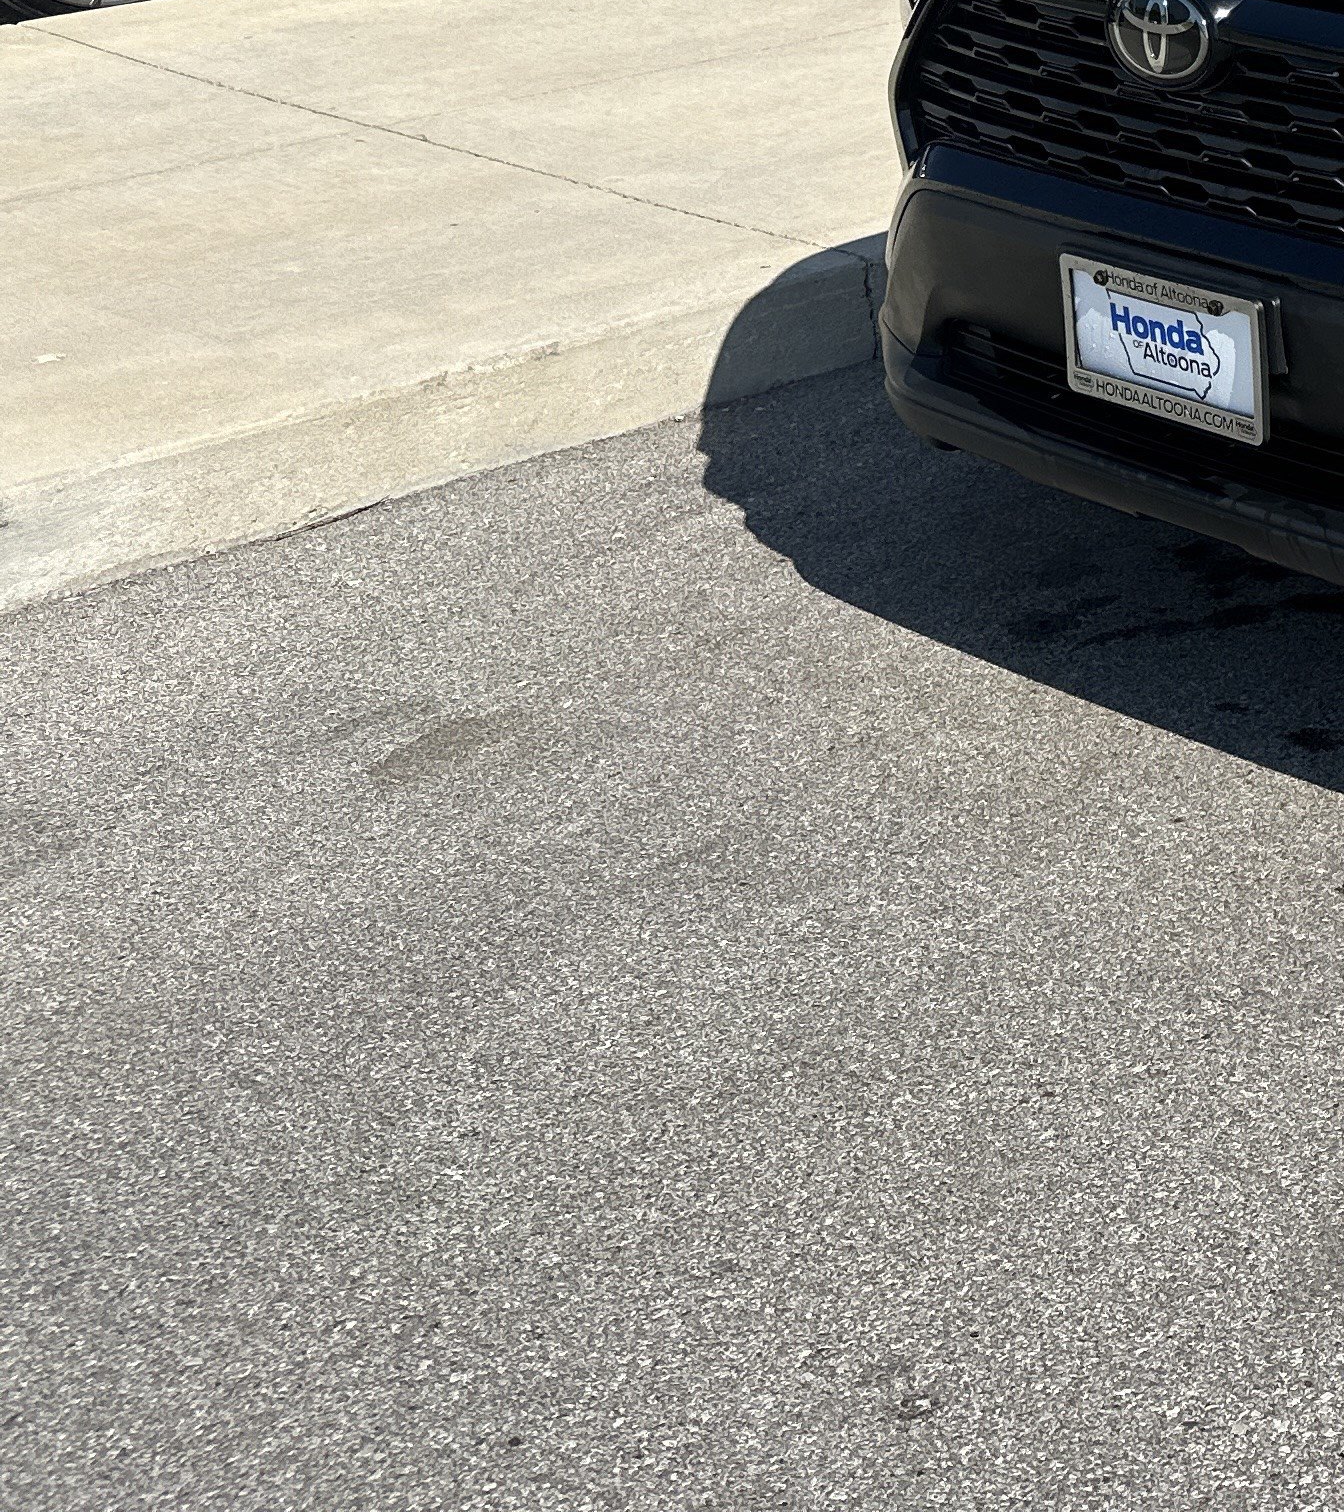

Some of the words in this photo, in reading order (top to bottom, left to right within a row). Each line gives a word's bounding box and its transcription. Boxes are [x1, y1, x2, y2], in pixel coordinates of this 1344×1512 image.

[1105, 269, 1144, 293] Honda
[1145, 282, 1159, 299] of
[1161, 285, 1209, 309] Altoona
[1109, 302, 1204, 356] Honda
[1143, 342, 1213, 379] Altoona
[1095, 378, 1235, 433] HONDAALTOONA.COM
